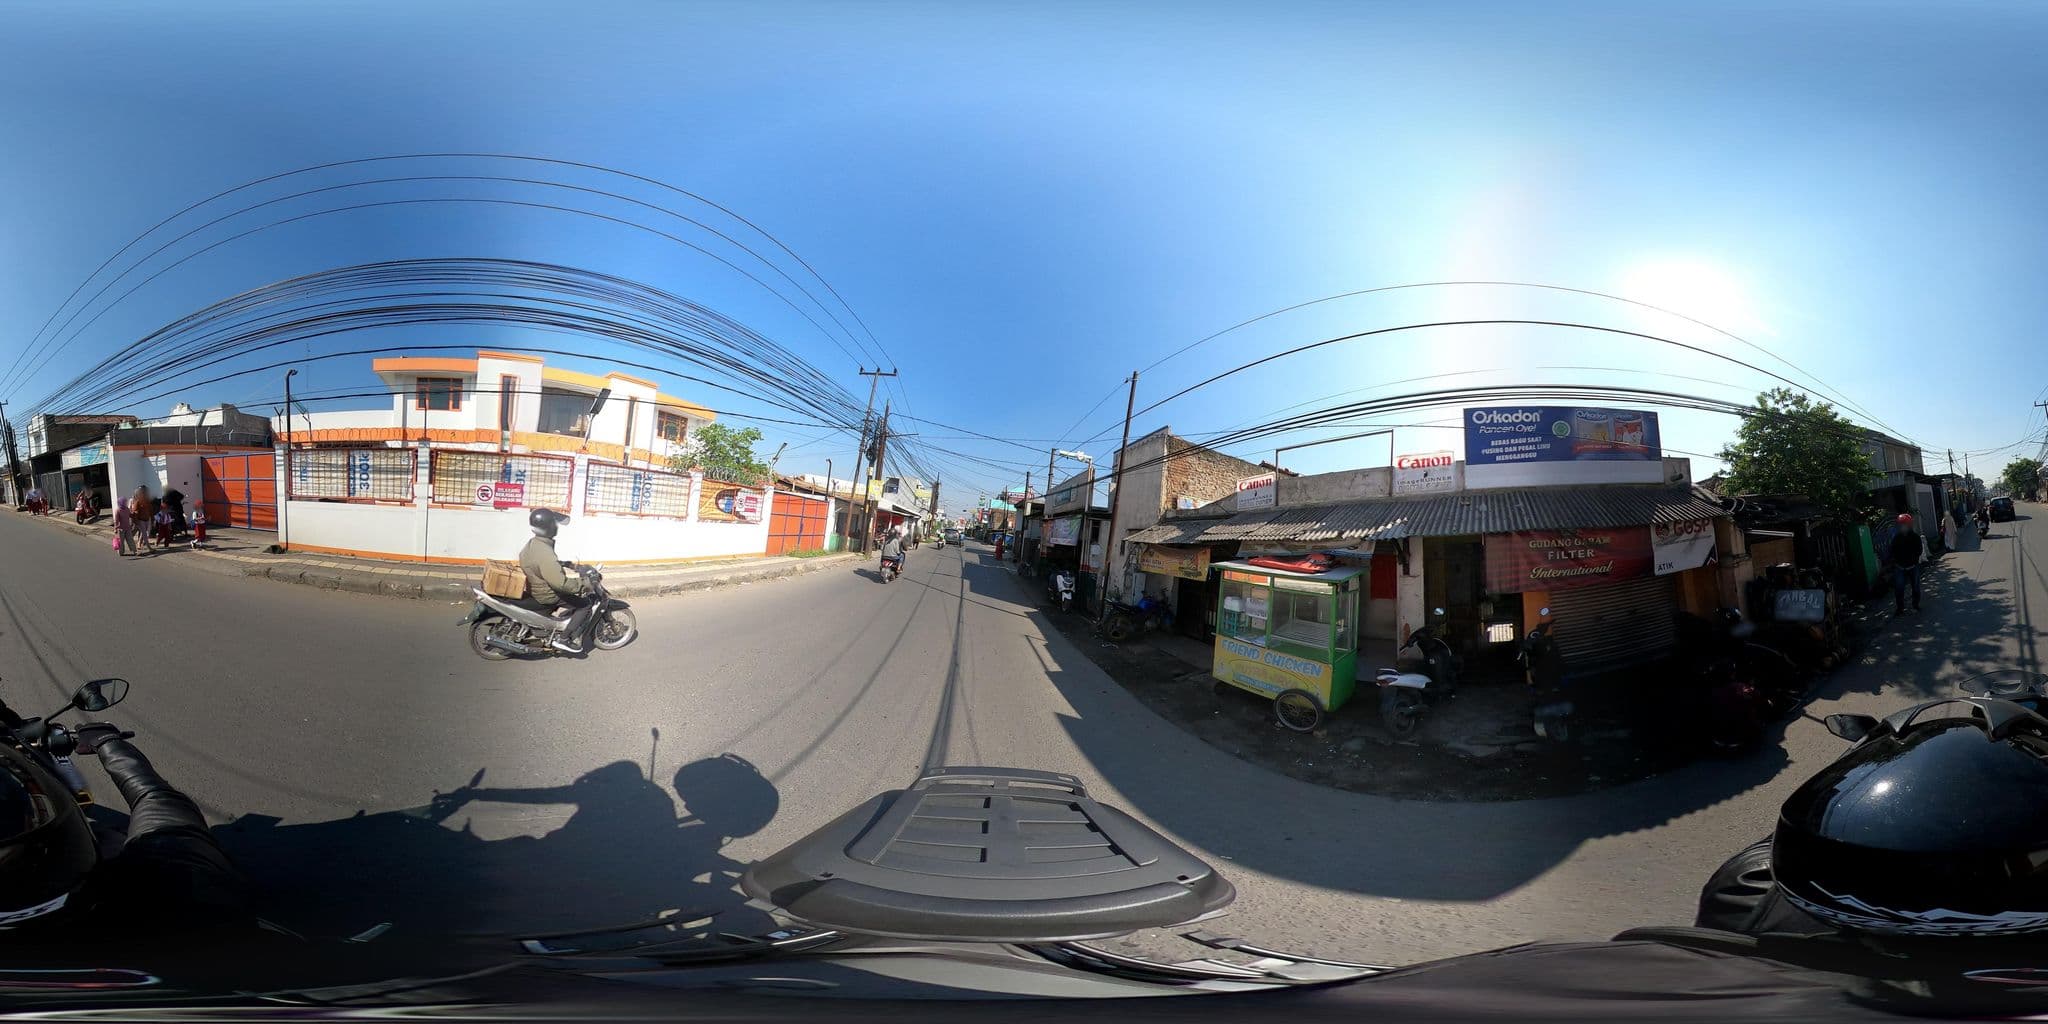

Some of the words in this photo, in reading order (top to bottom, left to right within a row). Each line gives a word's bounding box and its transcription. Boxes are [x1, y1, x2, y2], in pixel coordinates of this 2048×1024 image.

[1472, 409, 1540, 424] Oskadon
[1479, 425, 1514, 434] Pancen
[1482, 446, 1503, 455] PUSING
[1397, 455, 1452, 470] Canon
[1239, 478, 1272, 491] Canon
[1529, 539, 1572, 549] GUDANG
[1548, 549, 1596, 560] FILTER
[1530, 560, 1615, 579] International
[1221, 640, 1260, 660] FRIEND
[1264, 650, 1324, 677] CHICKEN
